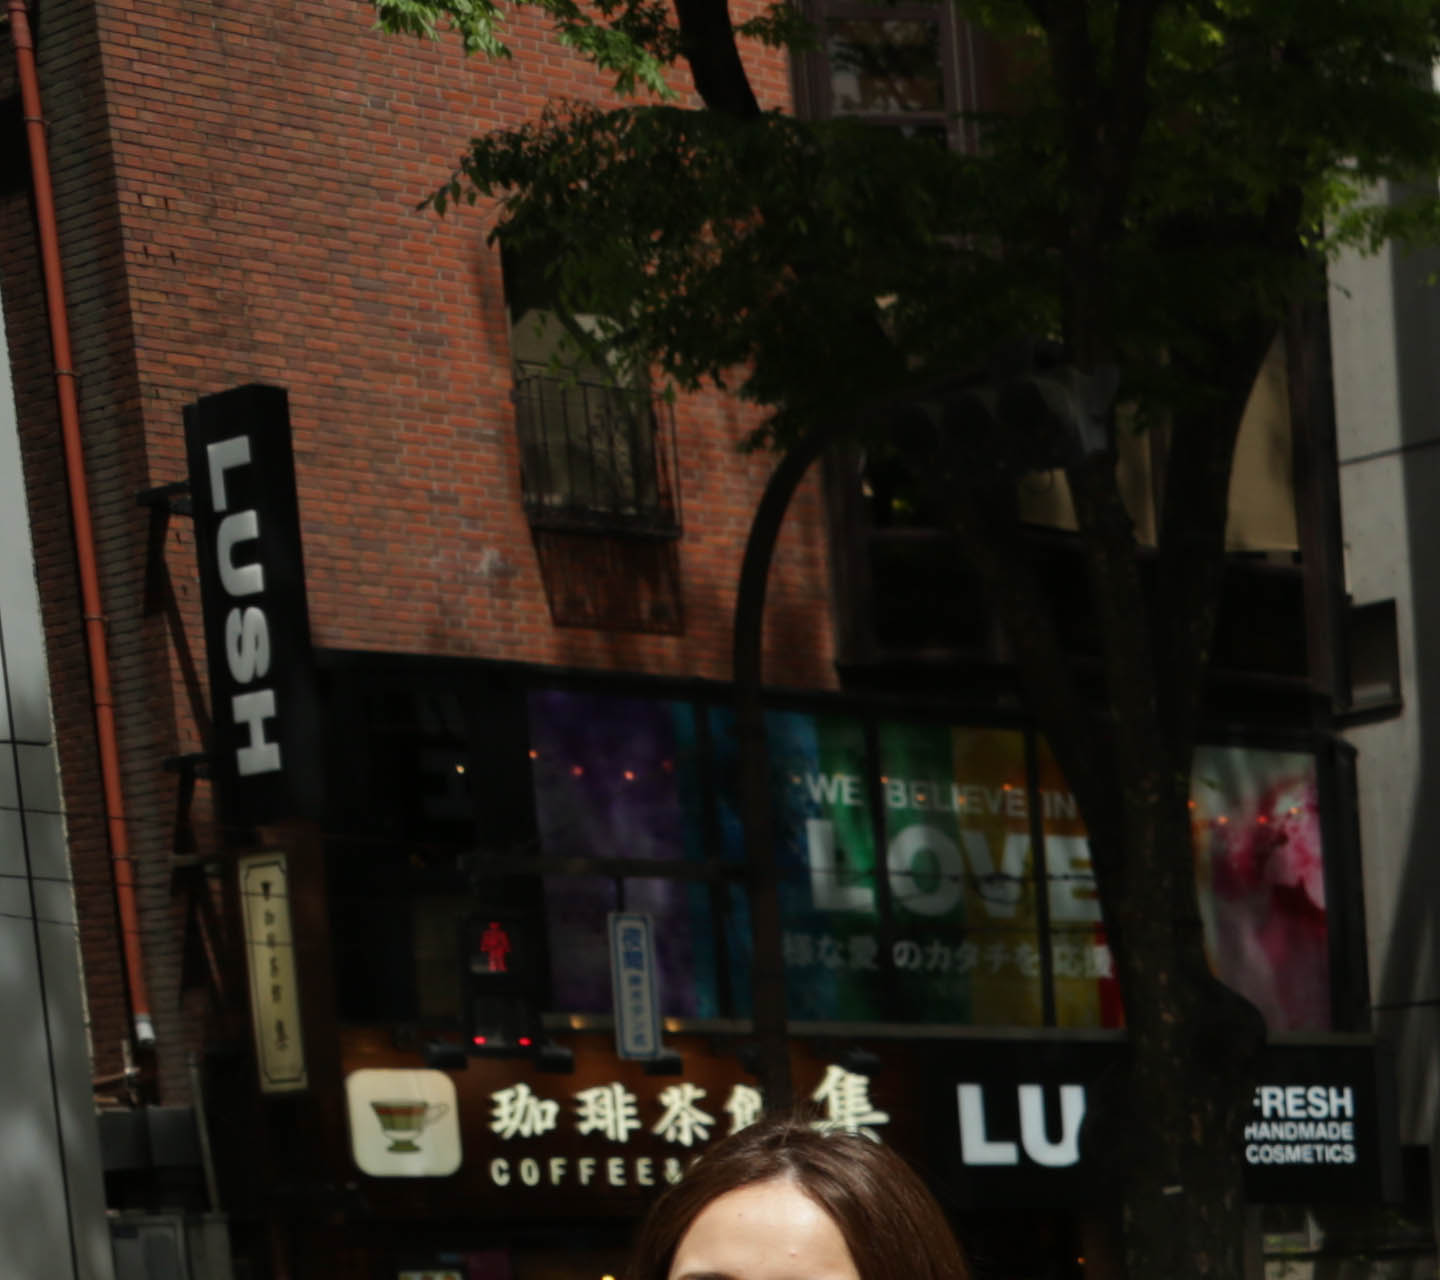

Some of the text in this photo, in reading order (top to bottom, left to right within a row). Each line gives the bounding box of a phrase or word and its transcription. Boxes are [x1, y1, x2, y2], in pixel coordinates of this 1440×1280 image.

[206, 434, 283, 777] LUSH
[806, 773, 865, 807] WE
[886, 778, 1030, 818] BELIEVE
[805, 817, 1104, 923] LOVE
[956, 1084, 1086, 1168] LU
[1244, 1120, 1356, 1142] HANDMADE
[1245, 1143, 1357, 1165] COSMETICS
